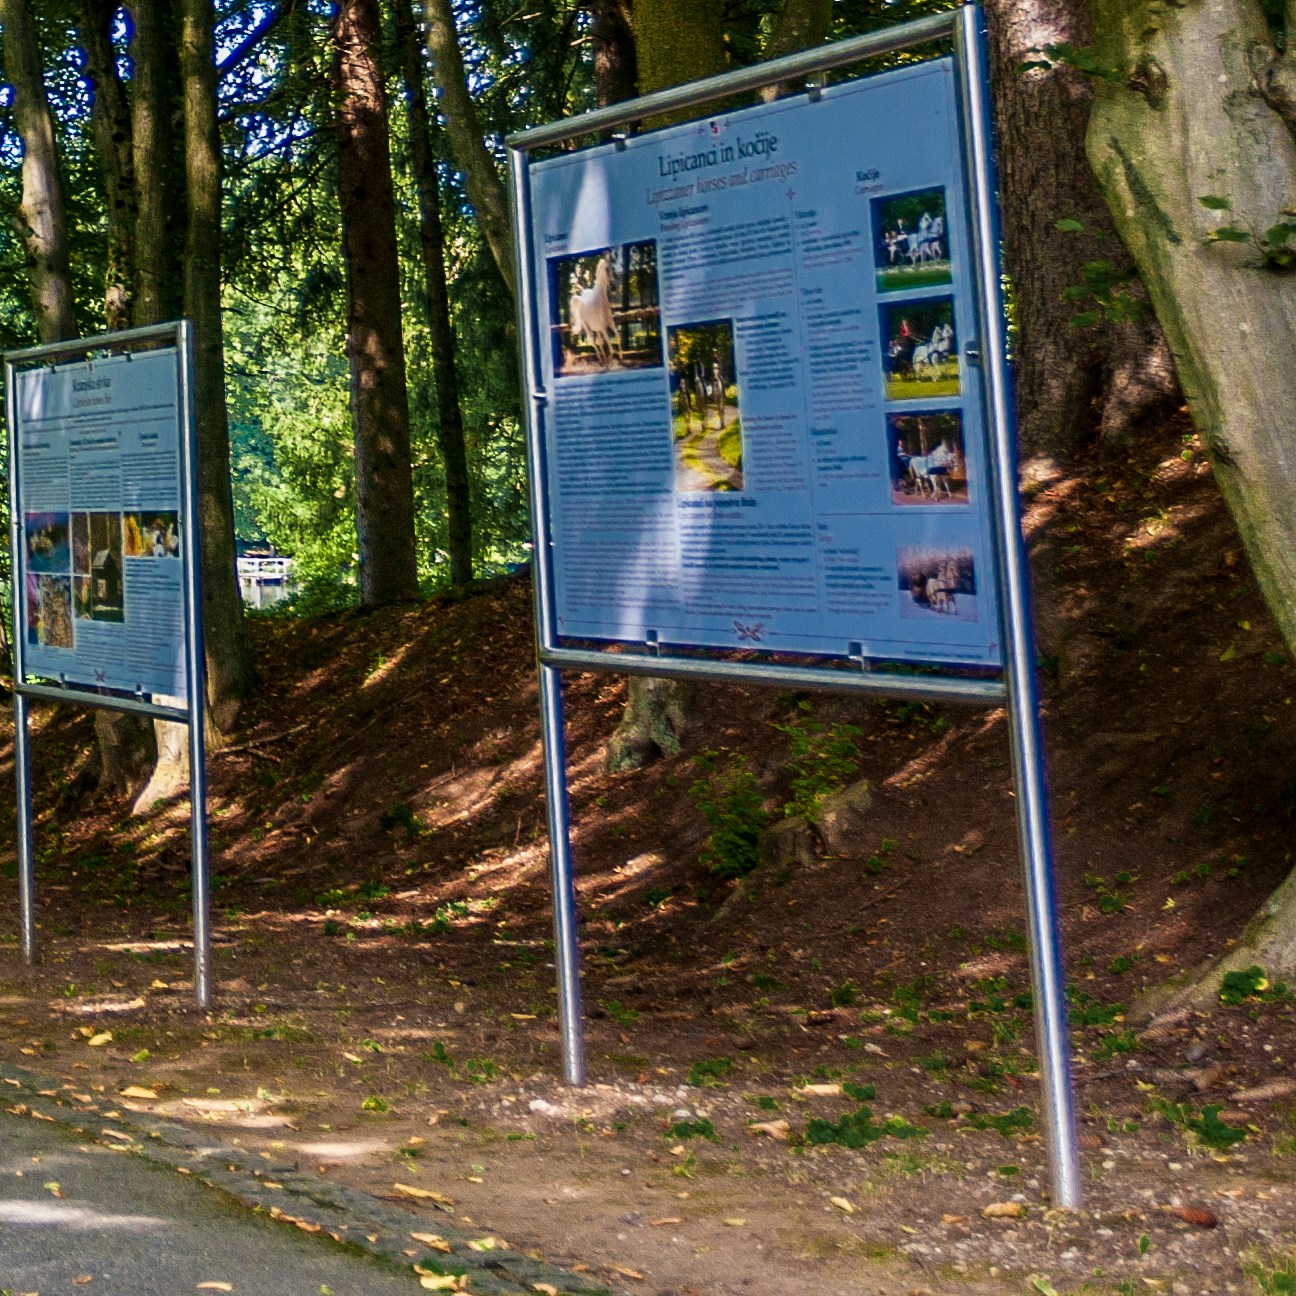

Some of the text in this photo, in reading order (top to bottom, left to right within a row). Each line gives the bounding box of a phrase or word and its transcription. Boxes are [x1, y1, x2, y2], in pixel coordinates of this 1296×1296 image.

[658, 132, 778, 181] Lipicanci in kočije
[696, 176, 727, 194] horses
[728, 166, 748, 188] and
[750, 161, 797, 184] carriages
